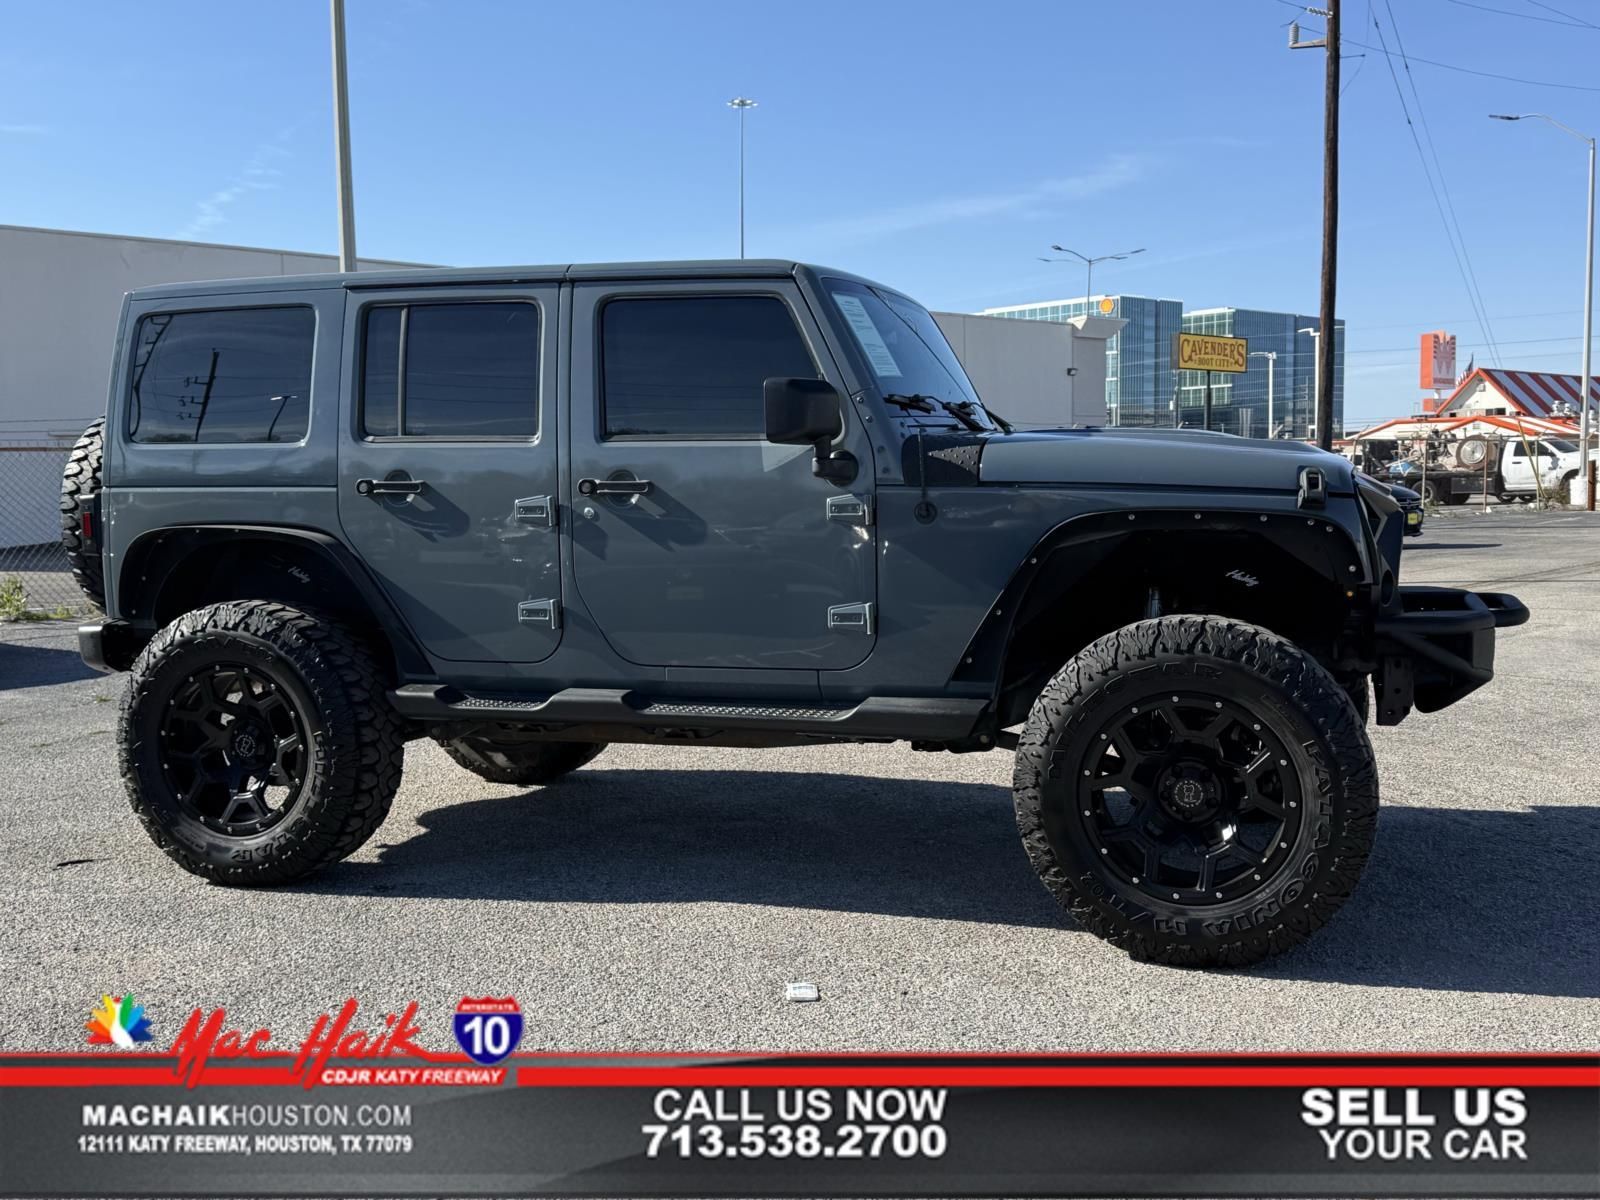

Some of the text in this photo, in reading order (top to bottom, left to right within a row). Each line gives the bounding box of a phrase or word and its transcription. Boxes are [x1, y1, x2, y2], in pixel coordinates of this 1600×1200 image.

[1181, 338, 1245, 367] CAVENDER'S
[1197, 357, 1232, 368] BOOT CITY
